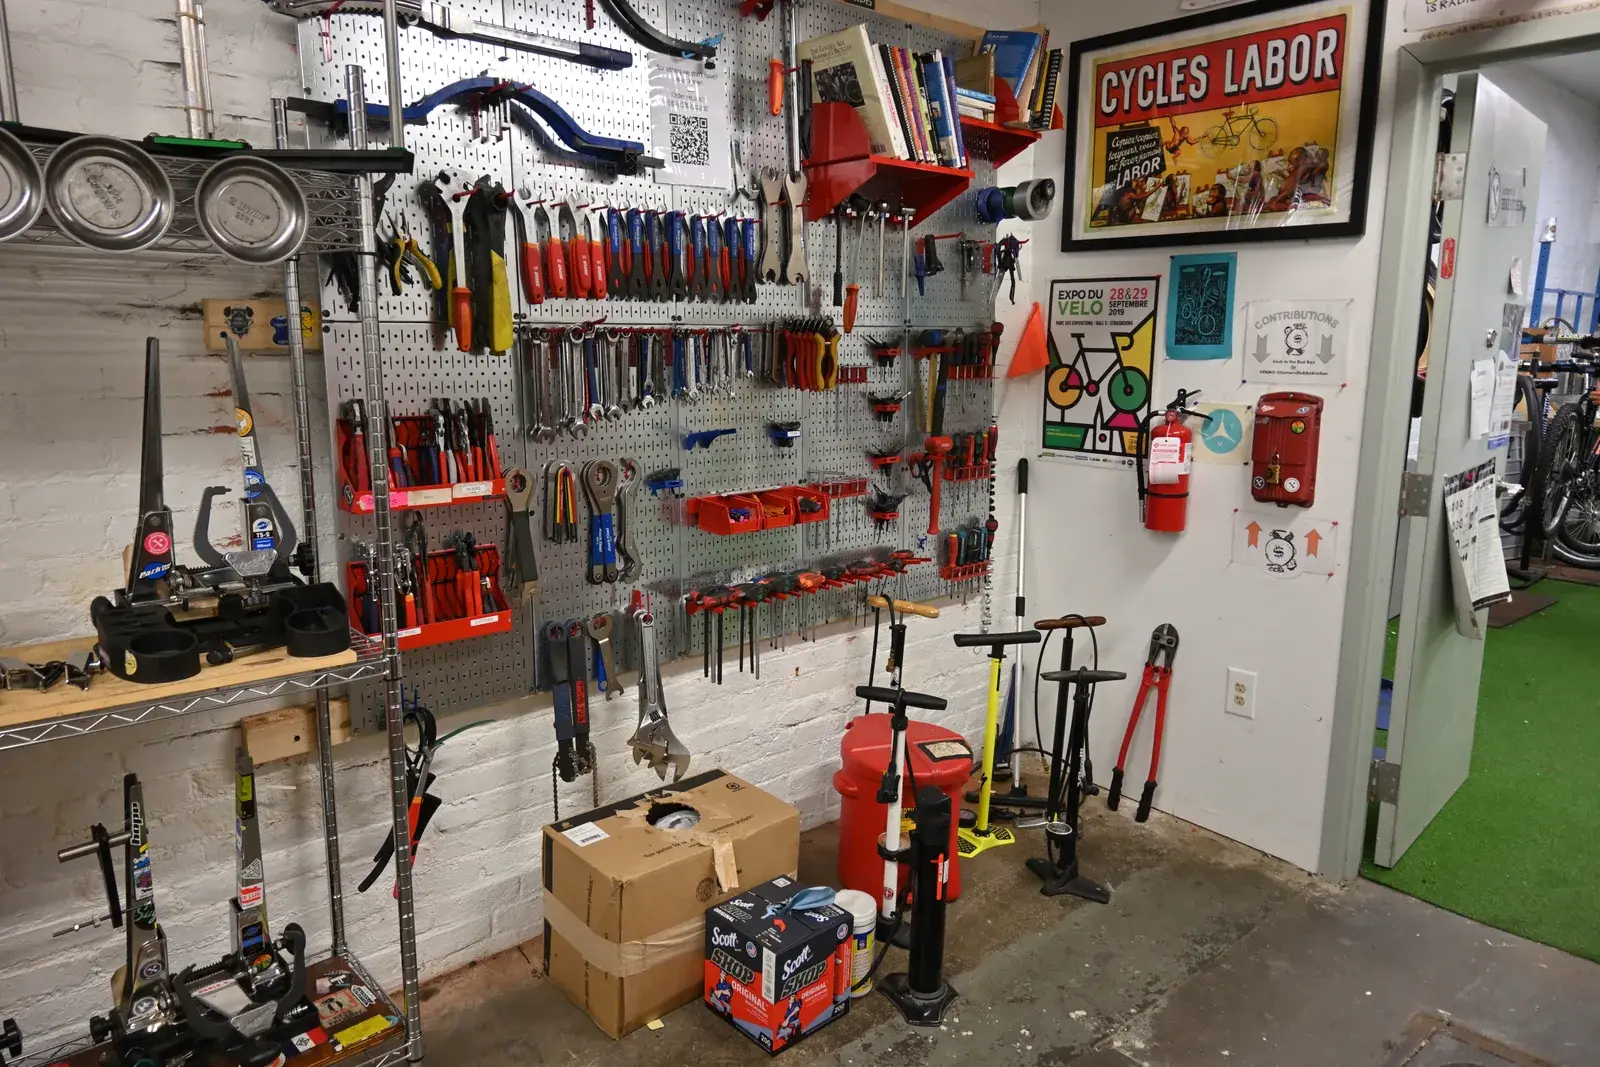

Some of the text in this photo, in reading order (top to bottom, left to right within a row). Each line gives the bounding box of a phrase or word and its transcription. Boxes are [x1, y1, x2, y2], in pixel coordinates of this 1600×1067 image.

[1426, 4, 1437, 13] IS
[1101, 54, 1208, 114] CYCLES
[1224, 28, 1338, 94] LABOR
[1115, 156, 1161, 191] LABOR
[1058, 288, 1148, 300] EXPO DU 28&29
[1058, 300, 1103, 315] VELO
[1109, 300, 1148, 308] SEPTEMBRE
[1109, 308, 1125, 316] 2019
[1254, 310, 1340, 330] CONTRIBUTIONS
[139, 566, 161, 580] Park
[130, 802, 143, 845] hope
[712, 926, 738, 947] Scott
[711, 948, 755, 985] SHOP
[781, 944, 810, 980] Scott
[780, 960, 827, 1000] SHOP
[732, 981, 767, 1011] ORIGINAL
[801, 983, 827, 999] ORIGINAL
[834, 1003, 846, 1014] 200
[760, 1034, 771, 1047] 200
